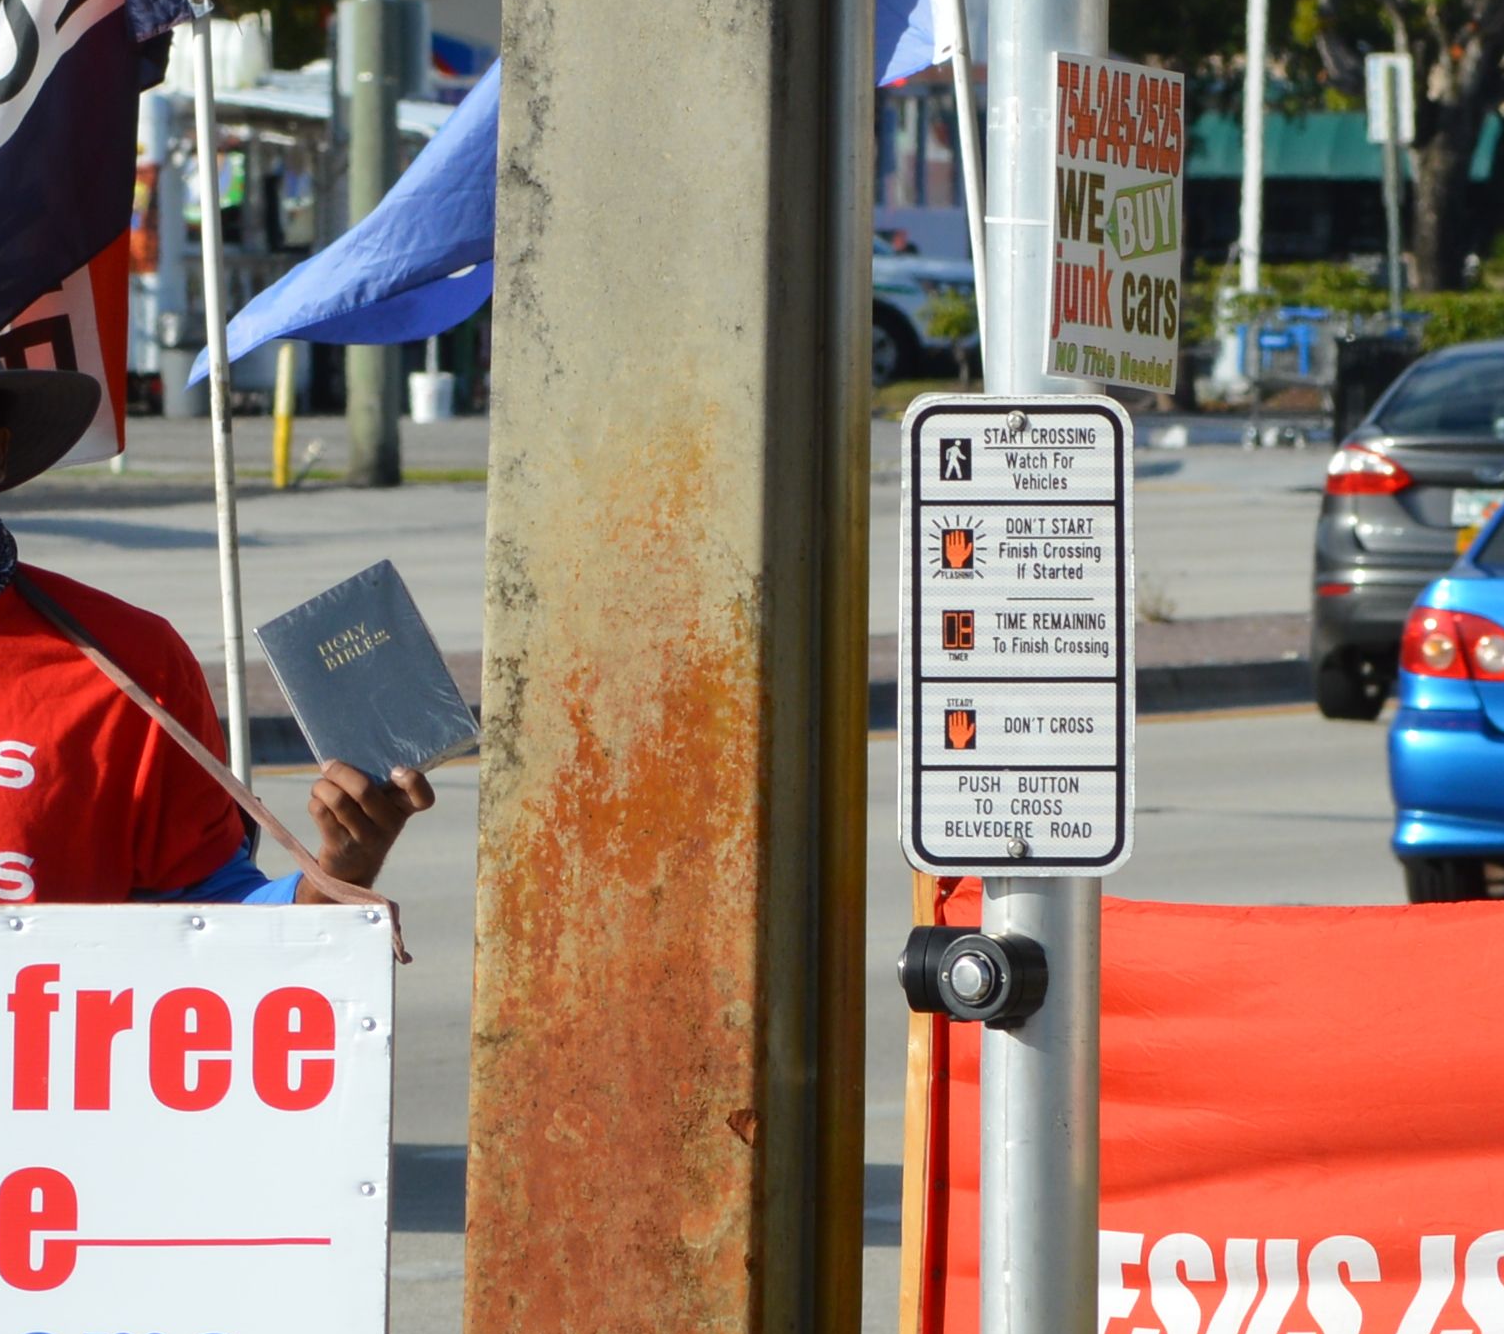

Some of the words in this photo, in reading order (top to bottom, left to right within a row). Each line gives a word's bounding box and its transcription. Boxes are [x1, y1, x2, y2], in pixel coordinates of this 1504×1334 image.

[1057, 60, 1182, 178] 754-245-2525
[1055, 165, 1105, 245] WE
[1116, 184, 1173, 257] BUY
[1052, 242, 1113, 339] junk
[1121, 271, 1178, 341] cars
[1053, 341, 1078, 374] NO
[1119, 350, 1174, 389] Needed
[983, 427, 1025, 445] START
[1030, 425, 1098, 446] CROSSING
[1004, 451, 1049, 470] Watch
[1053, 451, 1076, 470] For
[1011, 472, 1070, 492] Vehicles
[1004, 517, 1045, 537] DON'T
[1050, 517, 1095, 537] START
[997, 541, 1039, 561] Finish
[1042, 541, 1103, 564] Crossing
[1015, 562, 1024, 581] If
[1031, 562, 1085, 581] Started
[995, 613, 1027, 630] TIME
[1032, 613, 1108, 630] REMAINING
[317, 621, 366, 658] HOLY
[992, 636, 1007, 655] To
[1011, 636, 1050, 655] Finish
[1053, 636, 1110, 660] Crossing
[324, 635, 374, 672] BIBLE
[948, 652, 969, 662] TIMER
[946, 698, 974, 708] STEADY
[1004, 717, 1045, 735] DON'T
[1049, 717, 1094, 735] CROSS
[958, 775, 1002, 793] PUSH
[1017, 776, 1080, 794] BUTTON
[974, 798, 994, 816] TO
[1010, 798, 1064, 817] CROSS
[944, 820, 1034, 839] BELVEDERE
[1050, 822, 1093, 839] ROAD
[9, 965, 336, 1112] free
